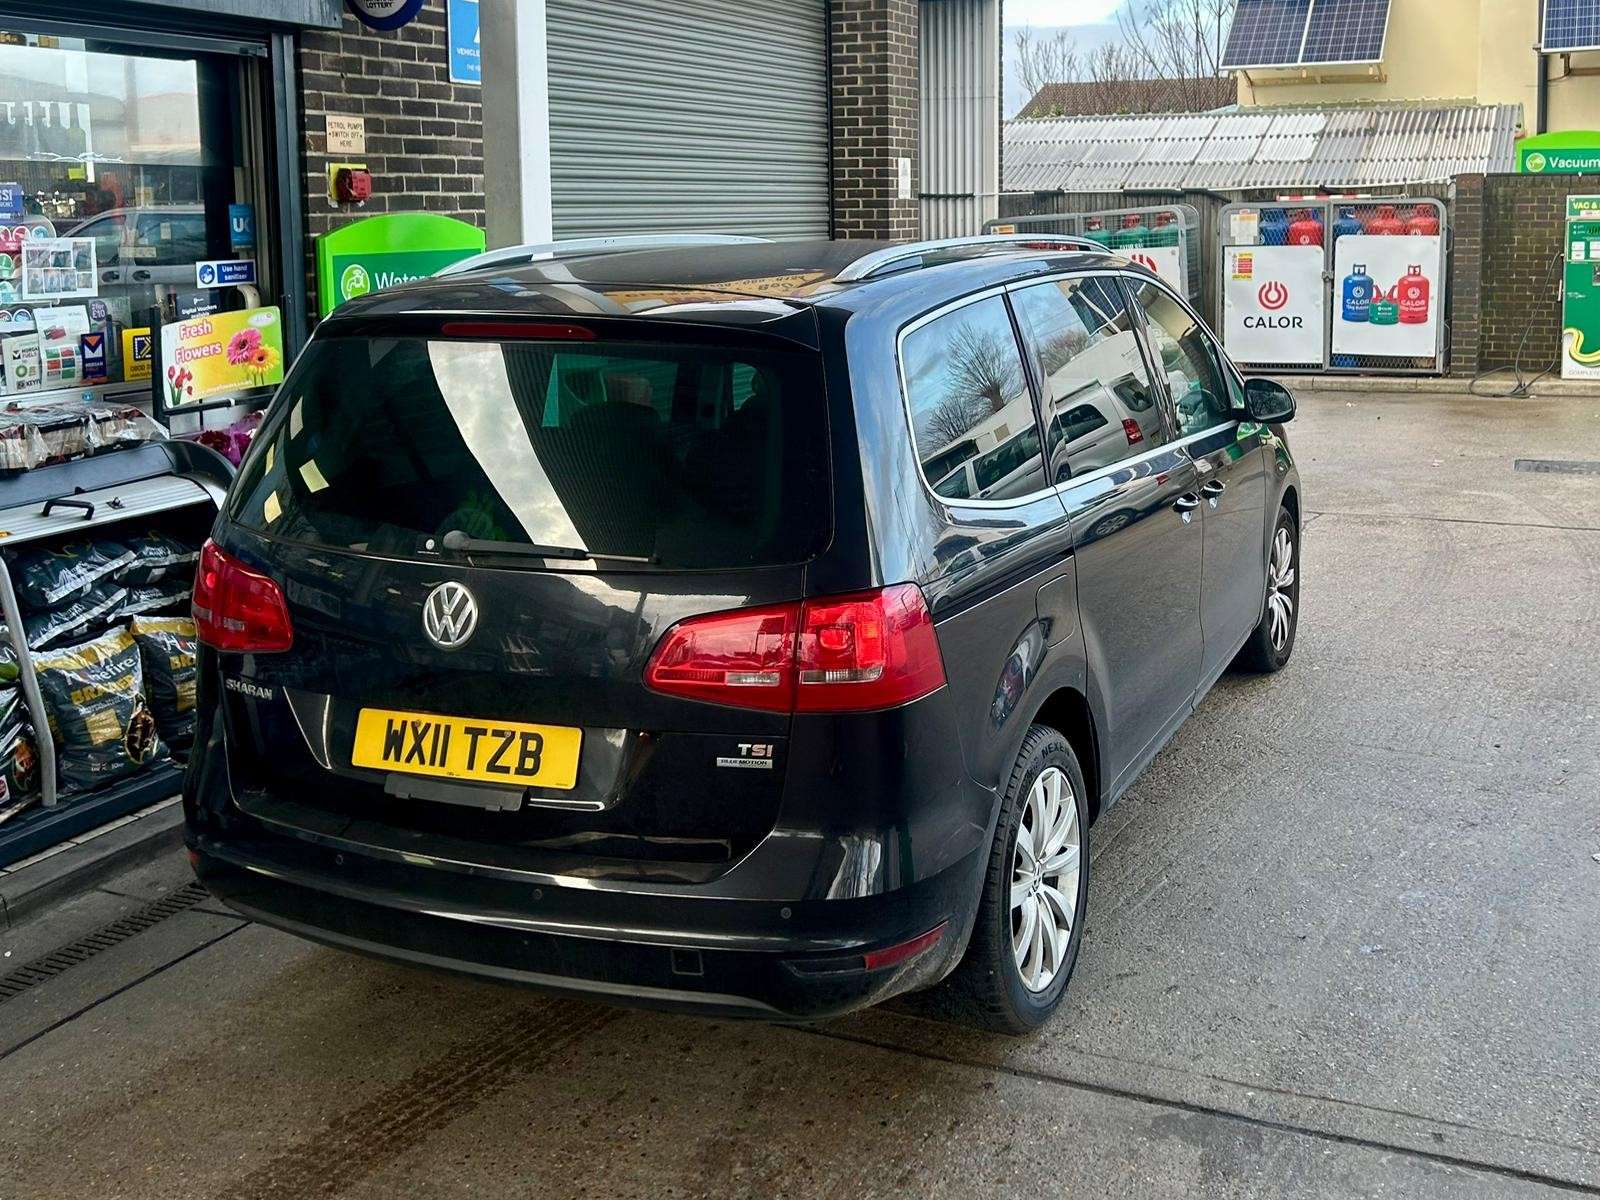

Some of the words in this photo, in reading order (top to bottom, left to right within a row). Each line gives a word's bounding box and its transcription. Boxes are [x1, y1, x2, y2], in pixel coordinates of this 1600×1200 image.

[328, 121, 346, 129] PETROL
[347, 122, 363, 130] PUMPS
[1549, 156, 1600, 168] Vacuum
[222, 265, 233, 273] Use
[233, 264, 248, 272] hand
[180, 319, 212, 340] Fresh
[1243, 316, 1304, 329] CALOR
[175, 341, 222, 364] Flowers
[225, 678, 273, 701] SHARAN
[382, 718, 452, 768] WX11
[463, 726, 544, 777] TZB
[737, 743, 774, 758] TSI
